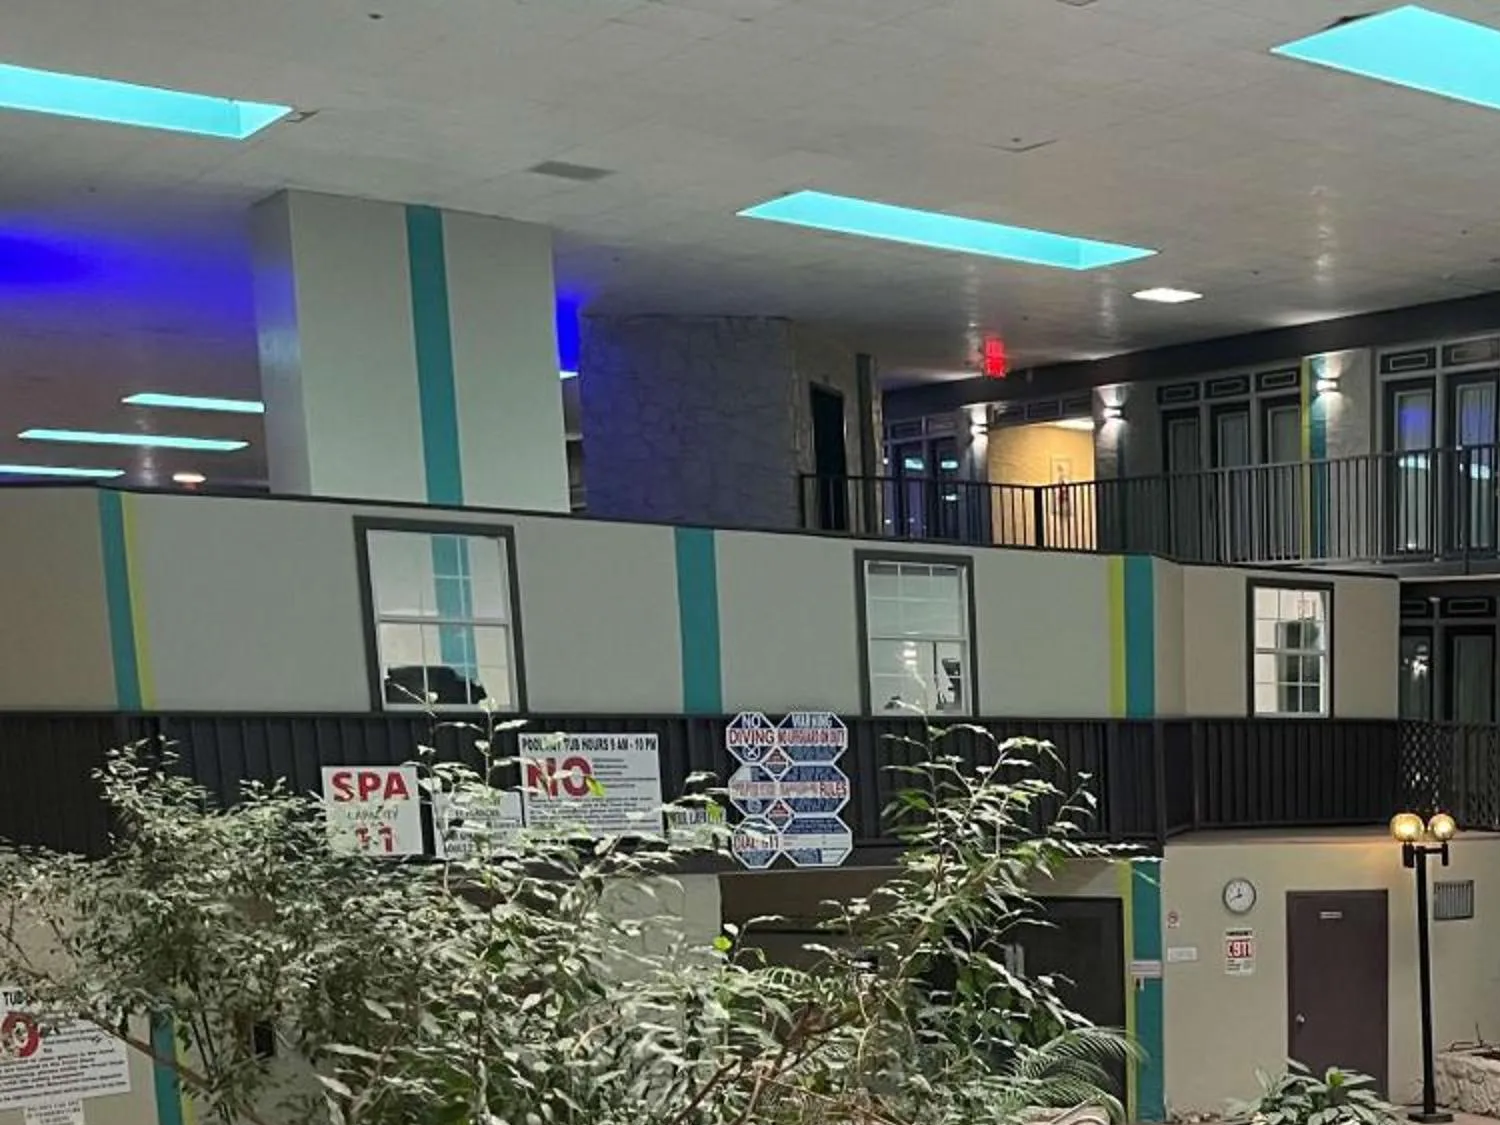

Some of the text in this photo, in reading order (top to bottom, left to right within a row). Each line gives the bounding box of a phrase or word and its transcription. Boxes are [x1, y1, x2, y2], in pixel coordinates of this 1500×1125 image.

[742, 715, 760, 728] NO
[582, 737, 609, 751] HOURS
[617, 737, 629, 751] AM
[645, 737, 657, 751] PM
[730, 729, 776, 744] DIVING
[526, 756, 592, 798] NO
[332, 772, 409, 802] SPA
